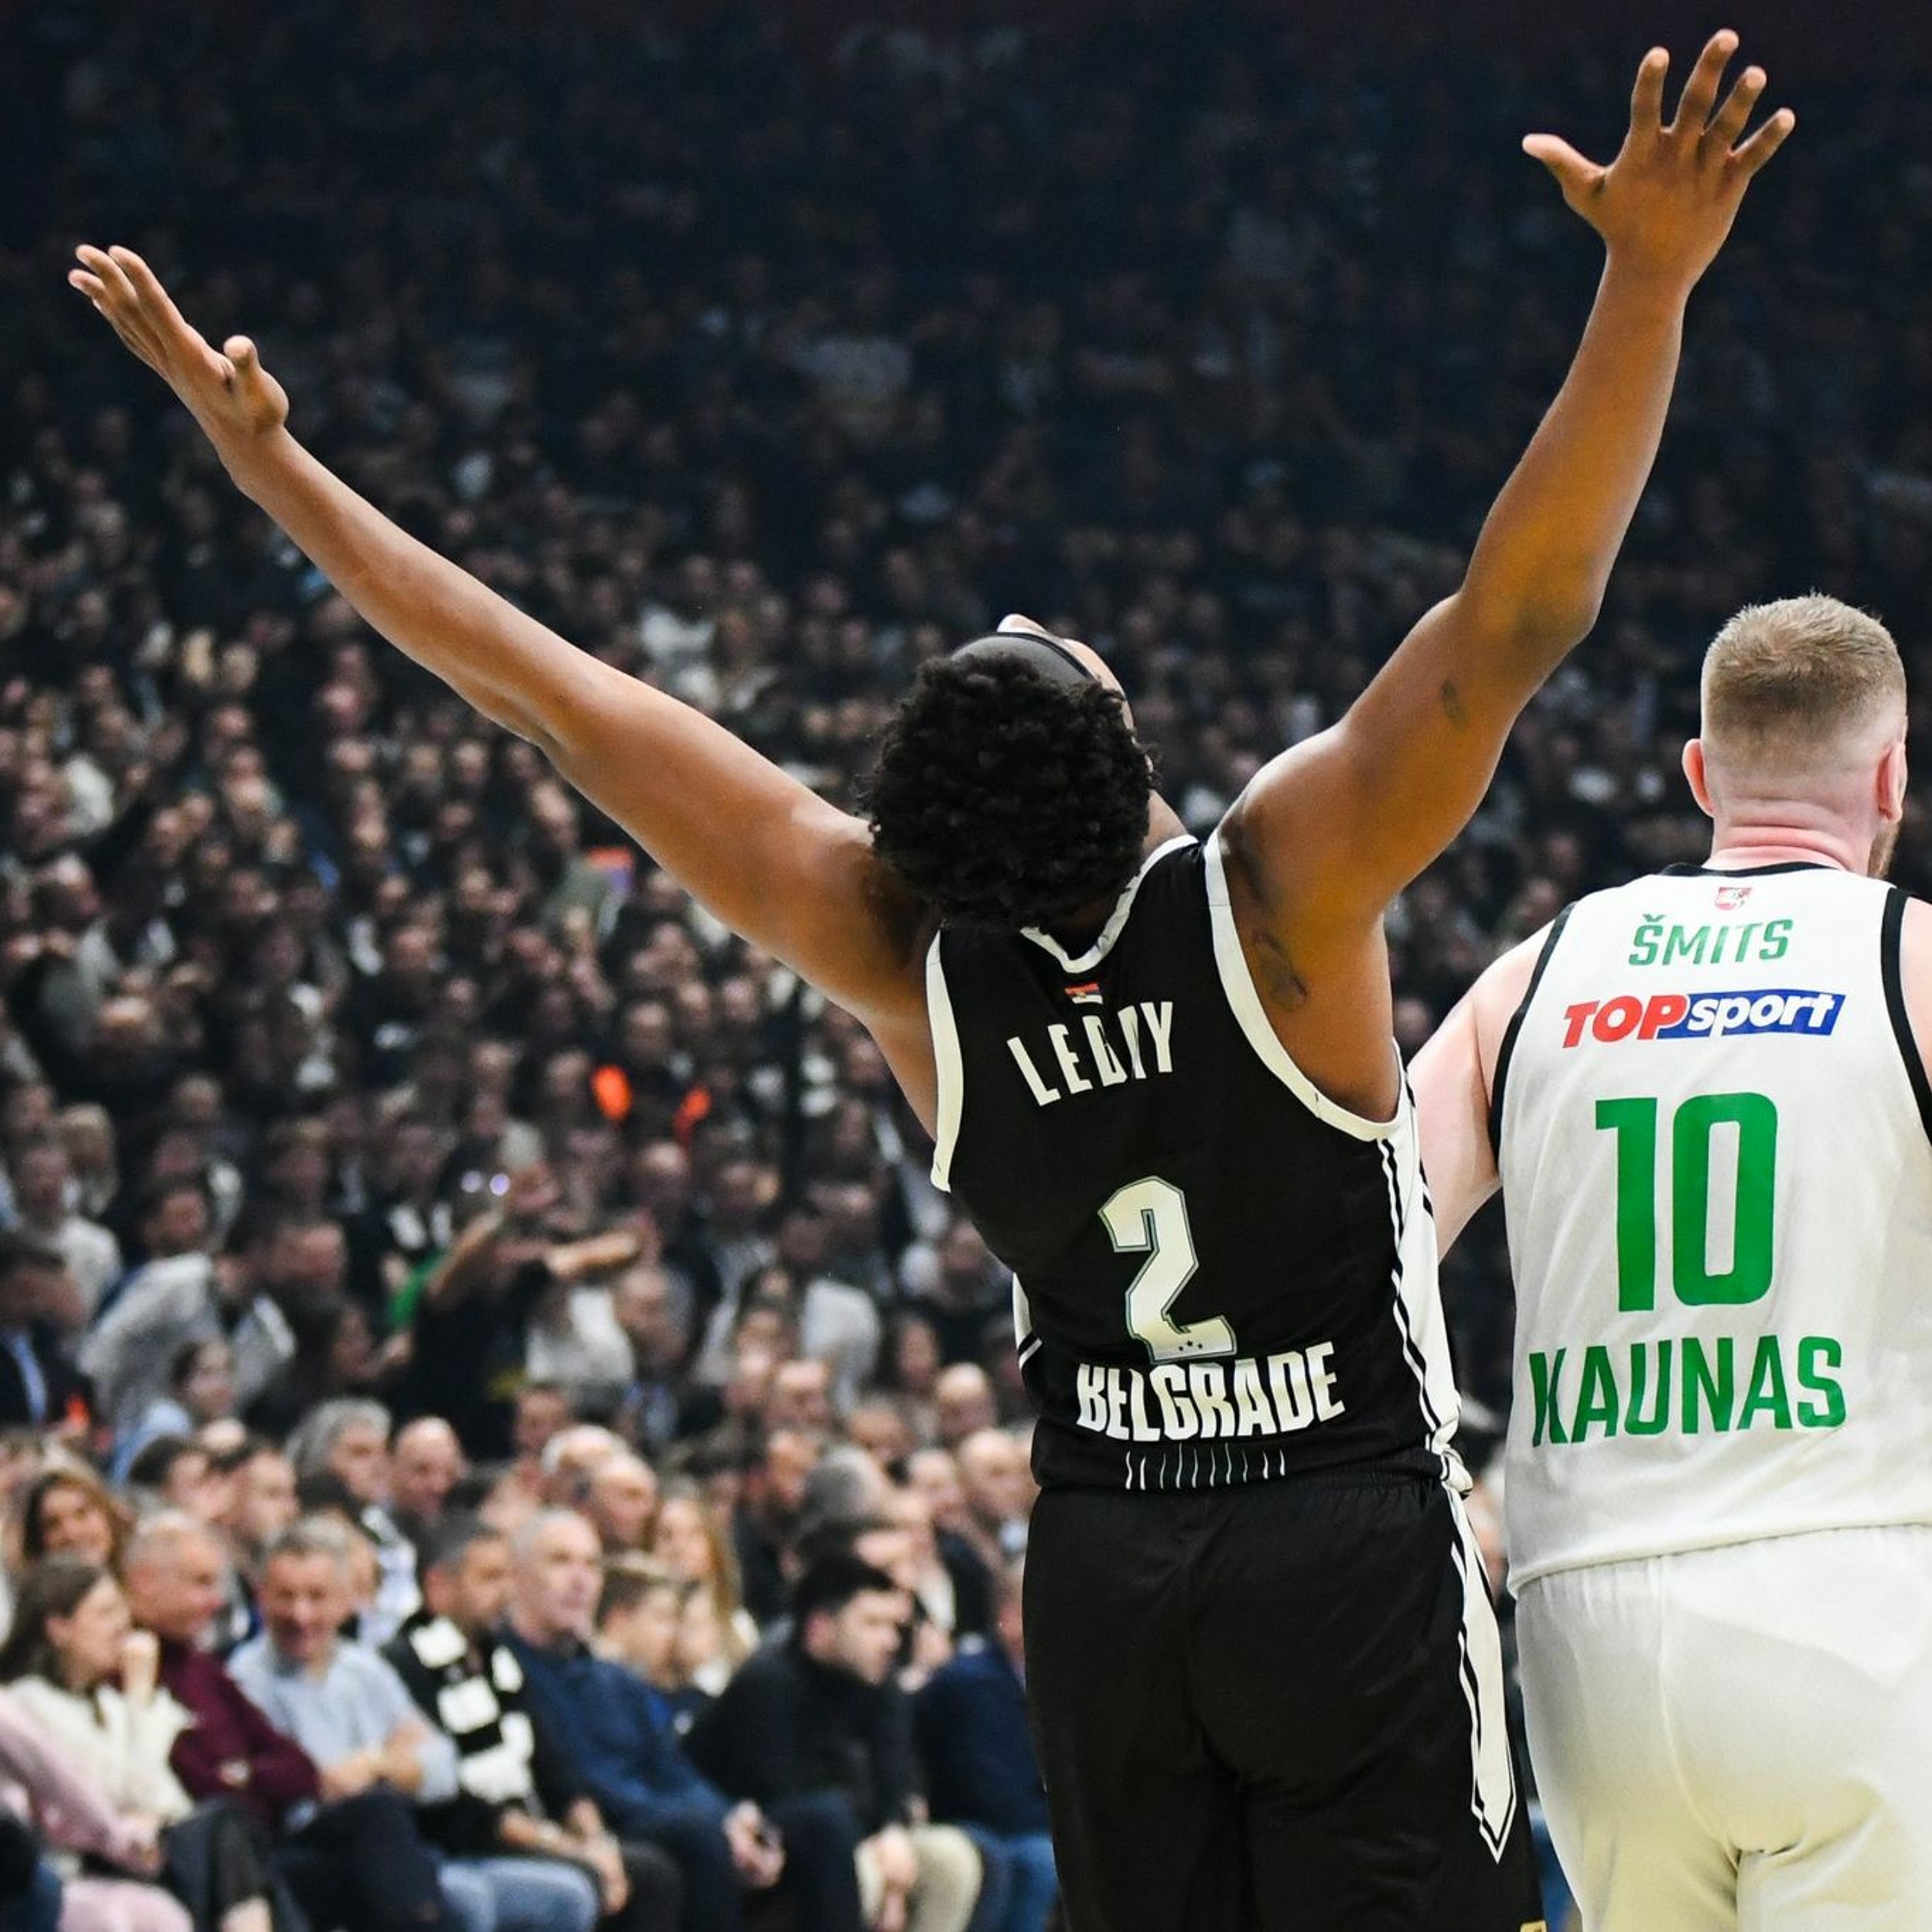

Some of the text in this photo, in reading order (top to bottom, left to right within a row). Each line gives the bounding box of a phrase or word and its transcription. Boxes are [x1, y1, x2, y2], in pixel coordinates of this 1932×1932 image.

[1629, 913, 1794, 967] ŠMITS
[1562, 993, 1837, 1048] TOPsport
[1595, 1091, 1779, 1313] 10
[1097, 1176, 1237, 1364] 2
[1076, 1341, 1345, 1442] BELGRADE
[1528, 1334, 1848, 1447] KAUNAS
